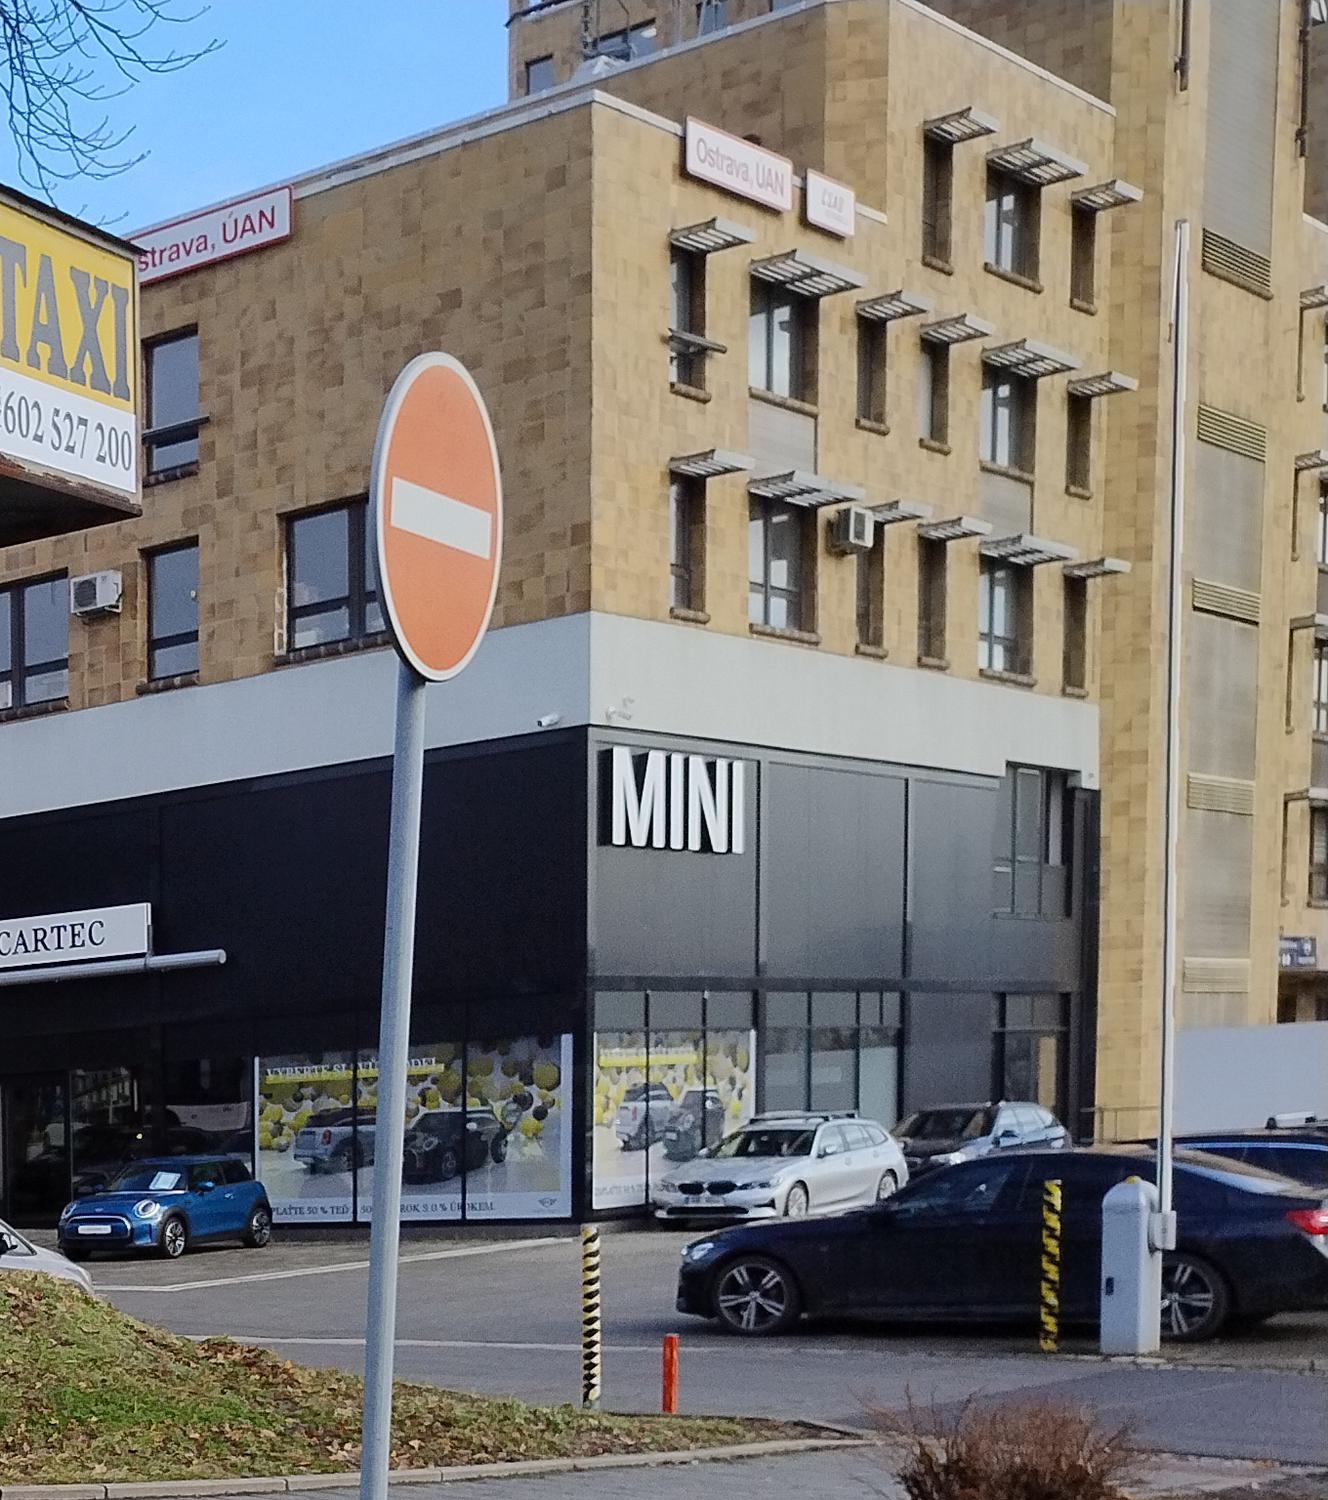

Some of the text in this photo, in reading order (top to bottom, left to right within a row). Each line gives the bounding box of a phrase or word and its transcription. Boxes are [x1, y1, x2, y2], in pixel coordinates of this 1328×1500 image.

[138, 205, 276, 272] strava, ÚAN
[4, 391, 132, 471] 602 527 200
[612, 745, 744, 855] MINI
